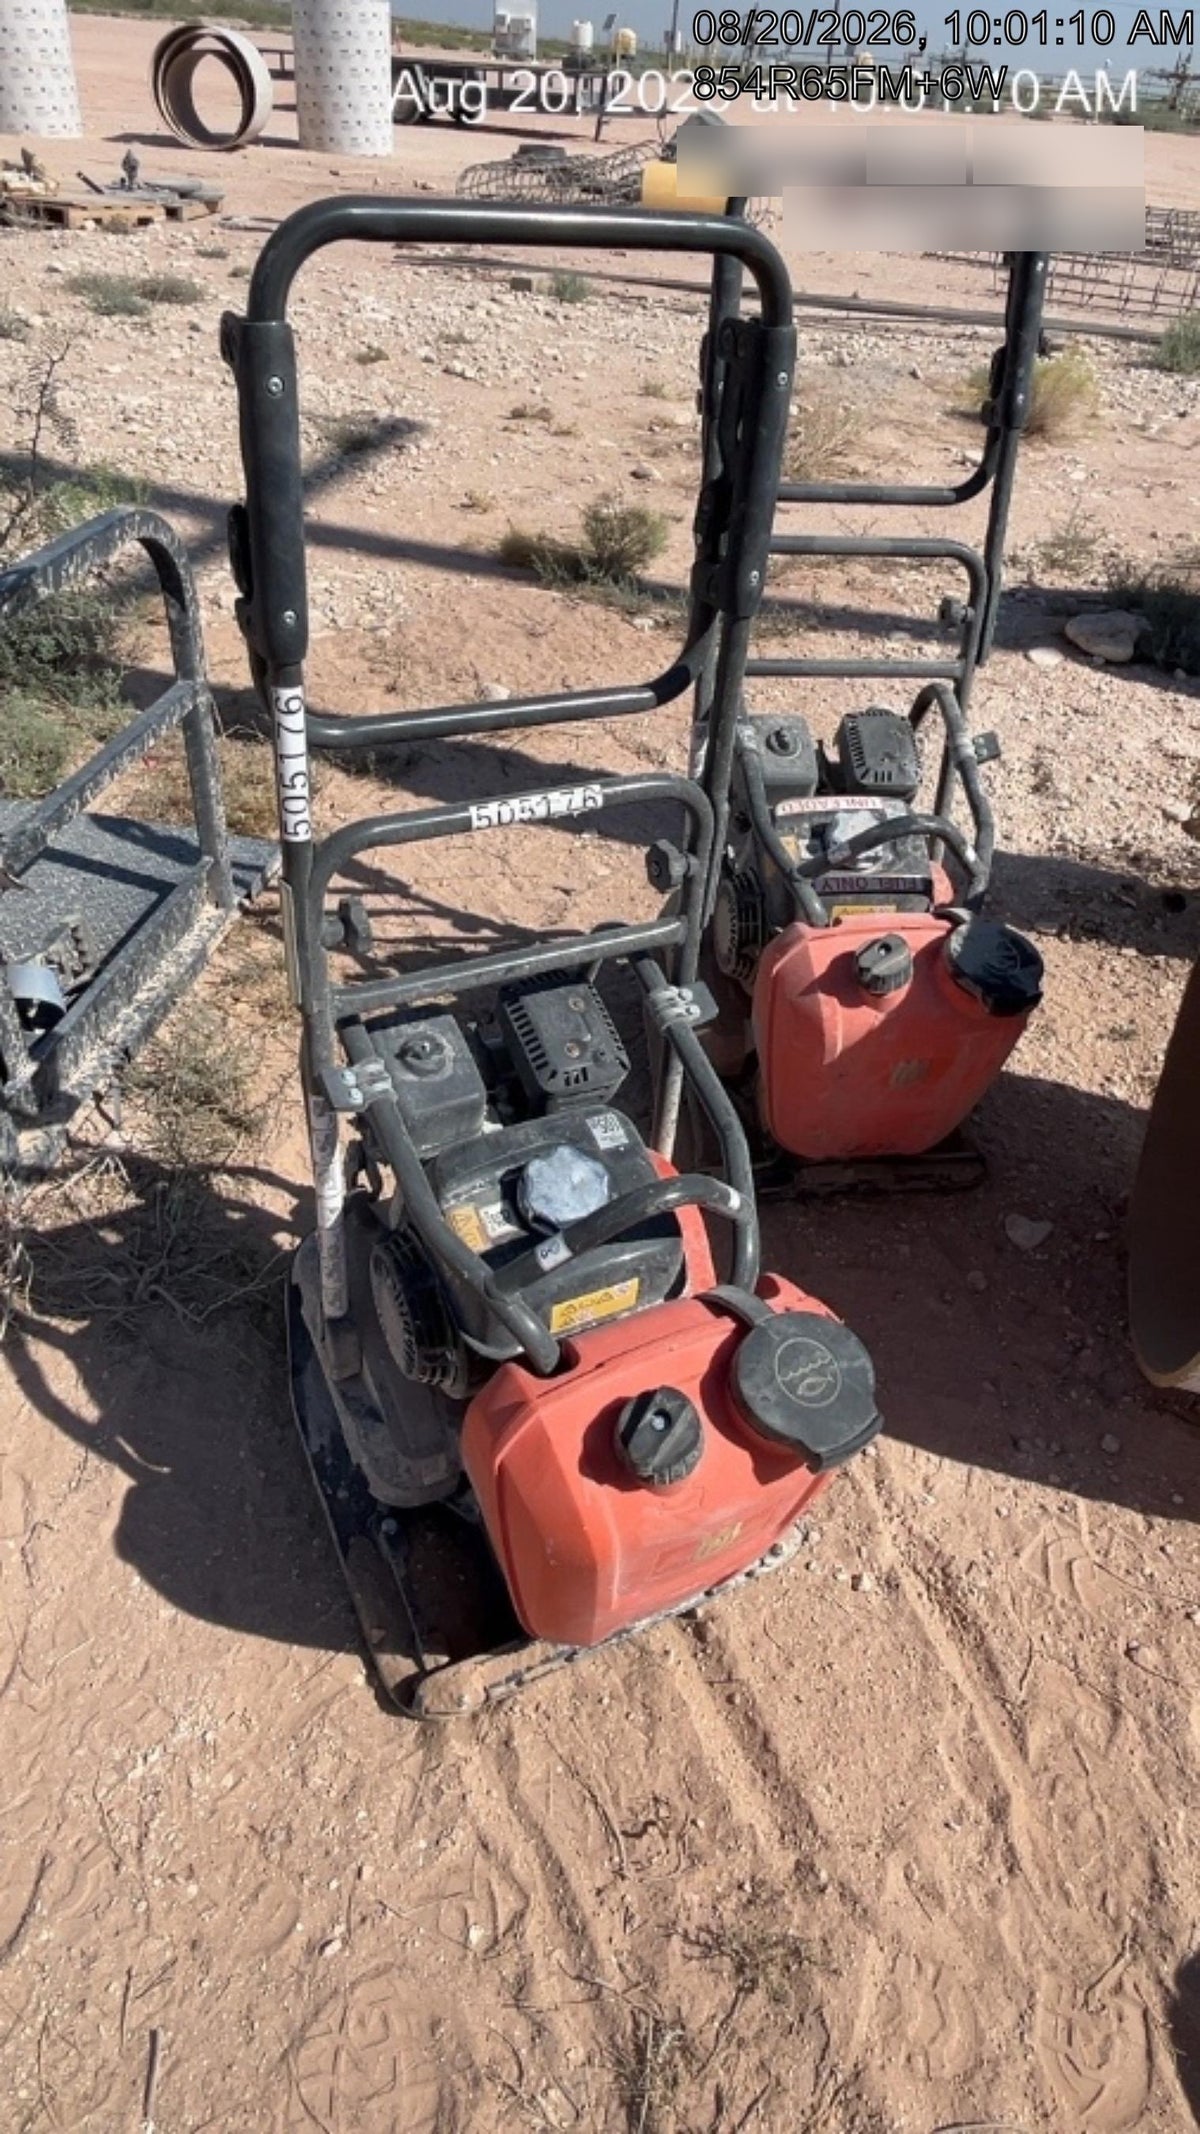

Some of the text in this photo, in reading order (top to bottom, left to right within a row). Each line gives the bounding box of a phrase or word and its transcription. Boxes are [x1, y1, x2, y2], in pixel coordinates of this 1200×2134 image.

[275, 694, 311, 838] 505176
[475, 784, 602, 829] 505176
[821, 877, 869, 891] ONLY
